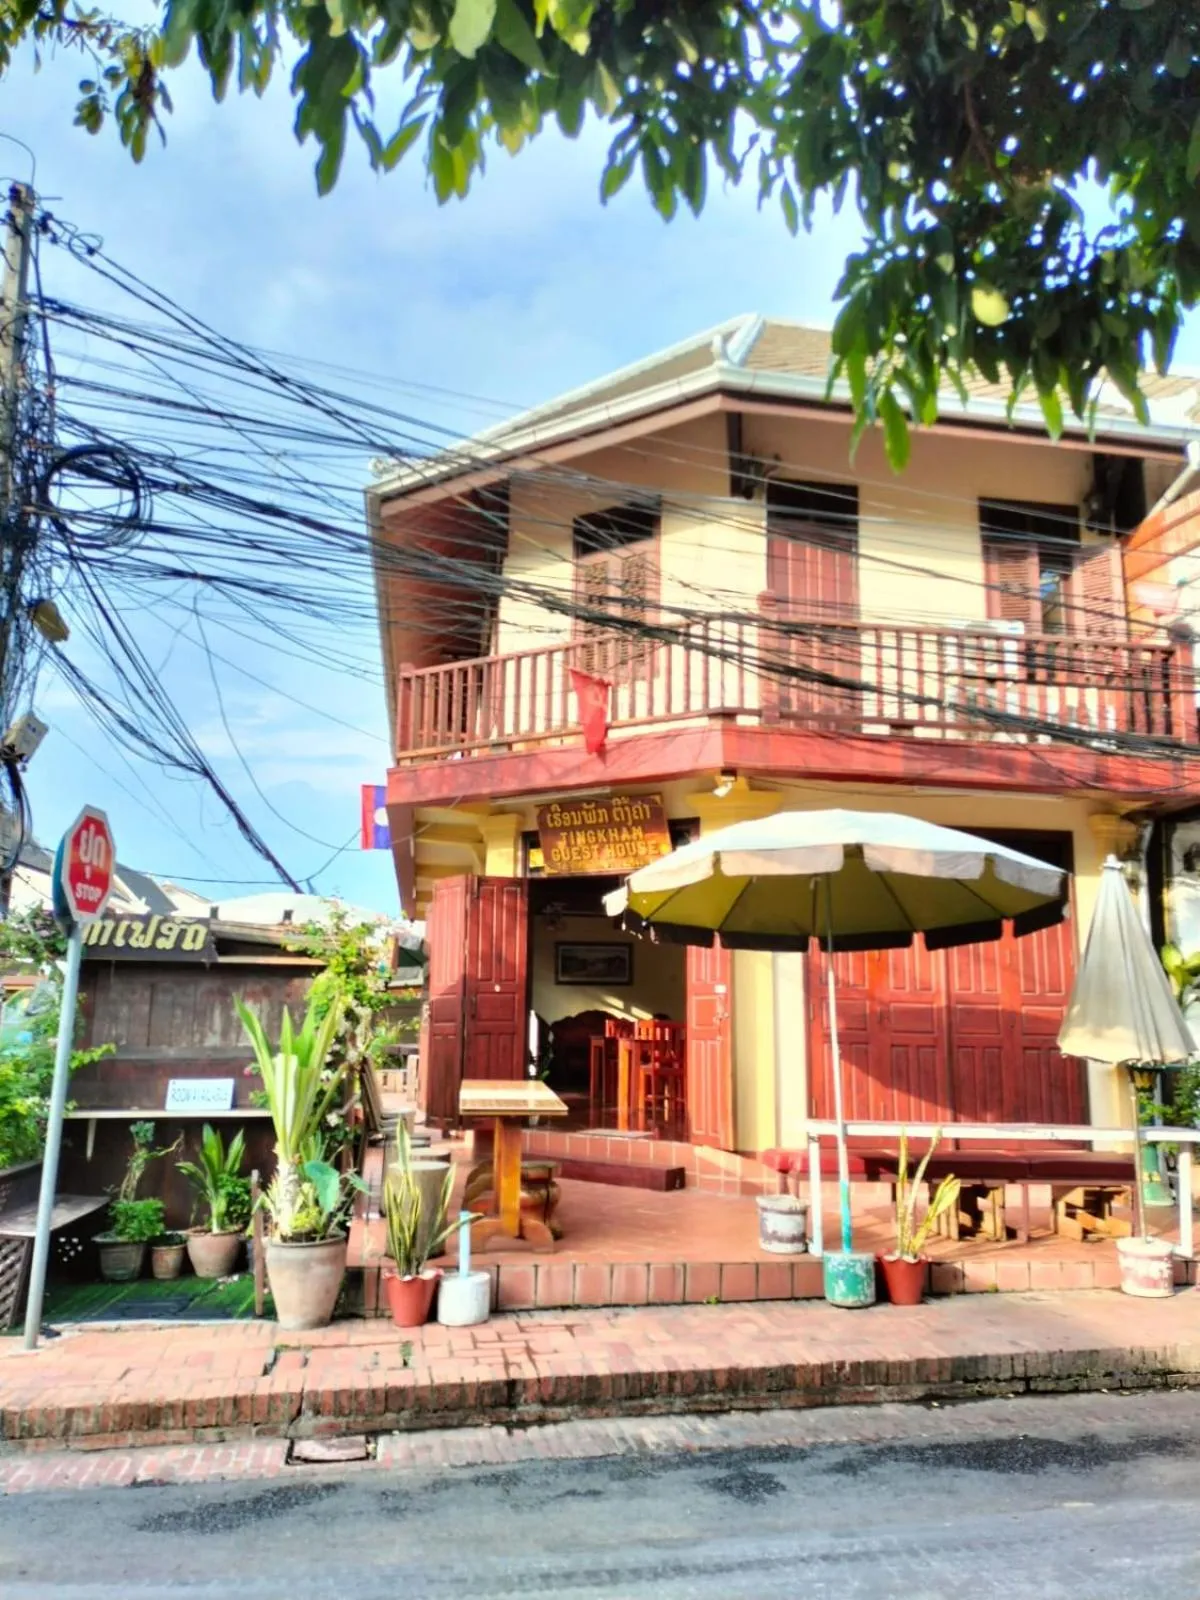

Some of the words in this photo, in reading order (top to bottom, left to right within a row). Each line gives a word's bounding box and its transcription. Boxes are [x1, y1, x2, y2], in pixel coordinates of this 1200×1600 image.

[560, 826, 643, 846] TINGKHAM
[551, 842, 601, 862] GUEST
[605, 839, 659, 858] HOUSE
[75, 881, 102, 902] STOP
